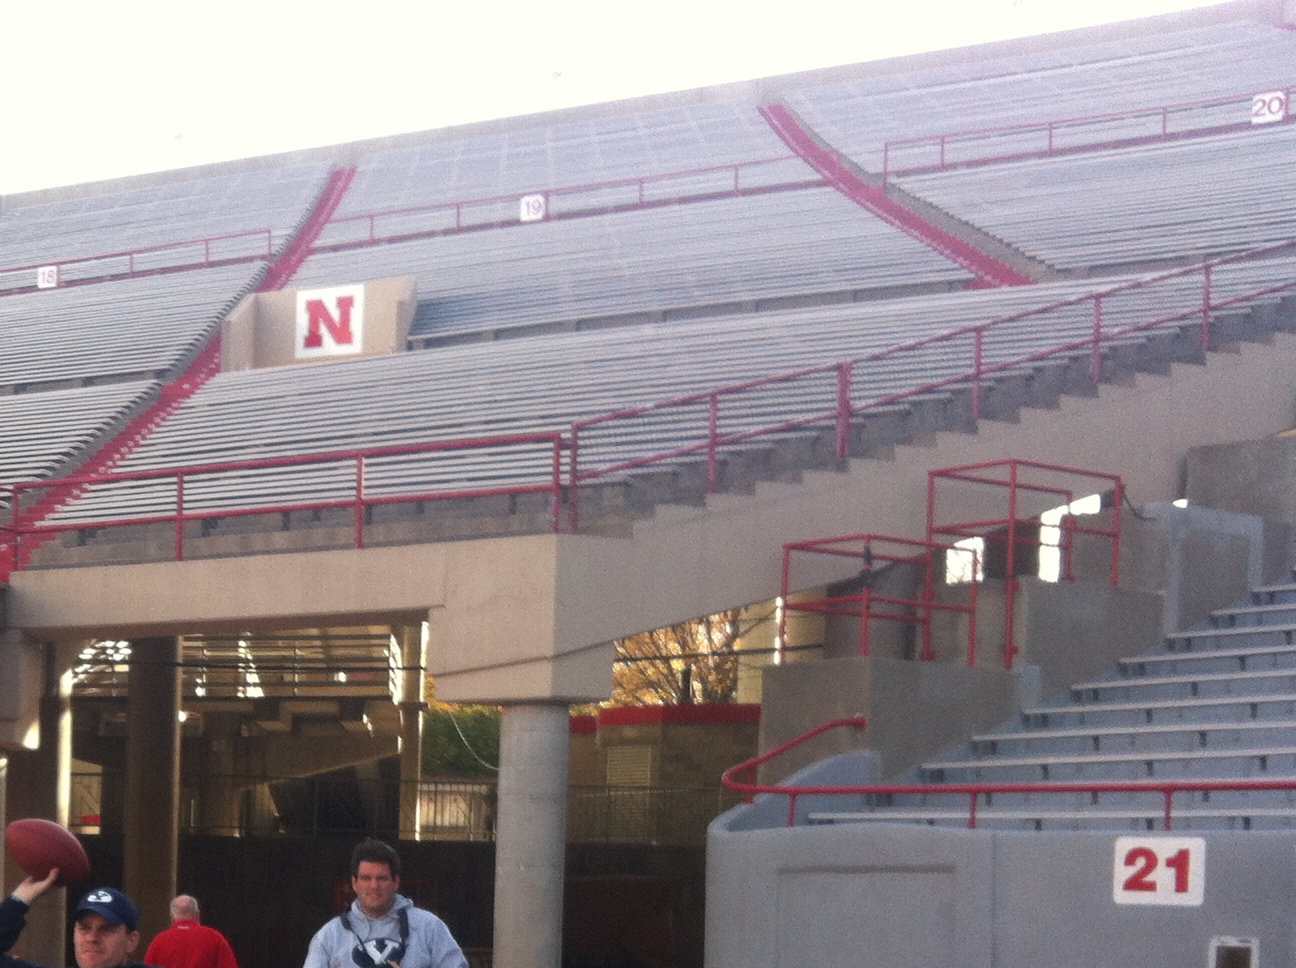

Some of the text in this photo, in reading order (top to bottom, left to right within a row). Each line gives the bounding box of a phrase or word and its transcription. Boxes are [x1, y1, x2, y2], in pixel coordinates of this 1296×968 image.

[1252, 97, 1284, 117] 20
[525, 199, 542, 216] 19
[304, 295, 354, 349] N
[1123, 847, 1190, 893] 21
